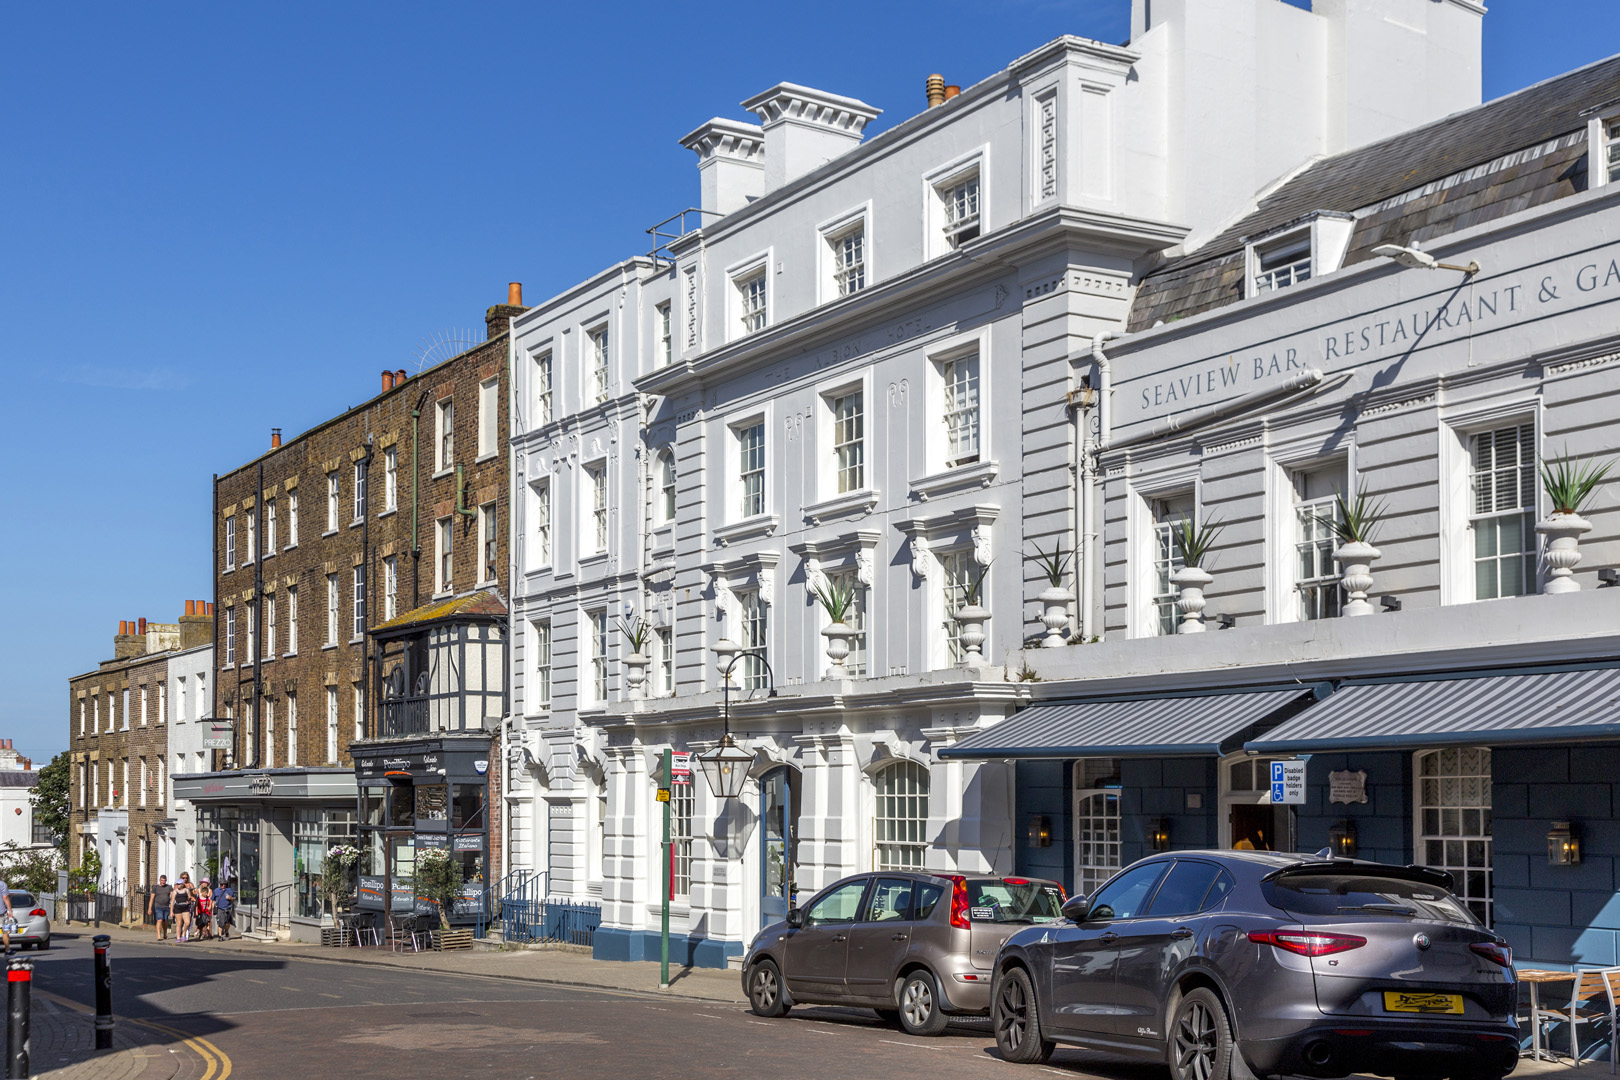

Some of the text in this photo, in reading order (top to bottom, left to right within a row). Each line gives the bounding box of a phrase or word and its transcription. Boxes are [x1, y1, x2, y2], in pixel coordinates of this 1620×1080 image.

[1141, 362, 1241, 410] SEAVIEW
[1253, 347, 1307, 382] BAR,
[1325, 284, 1522, 361] RESTAURANT
[1538, 275, 1561, 303] &
[764, 316, 932, 383] THE ALBION HOTEL
[203, 738, 232, 747] PREZZO
[383, 758, 411, 771] Posillipo
[361, 878, 384, 891] Posillipo
